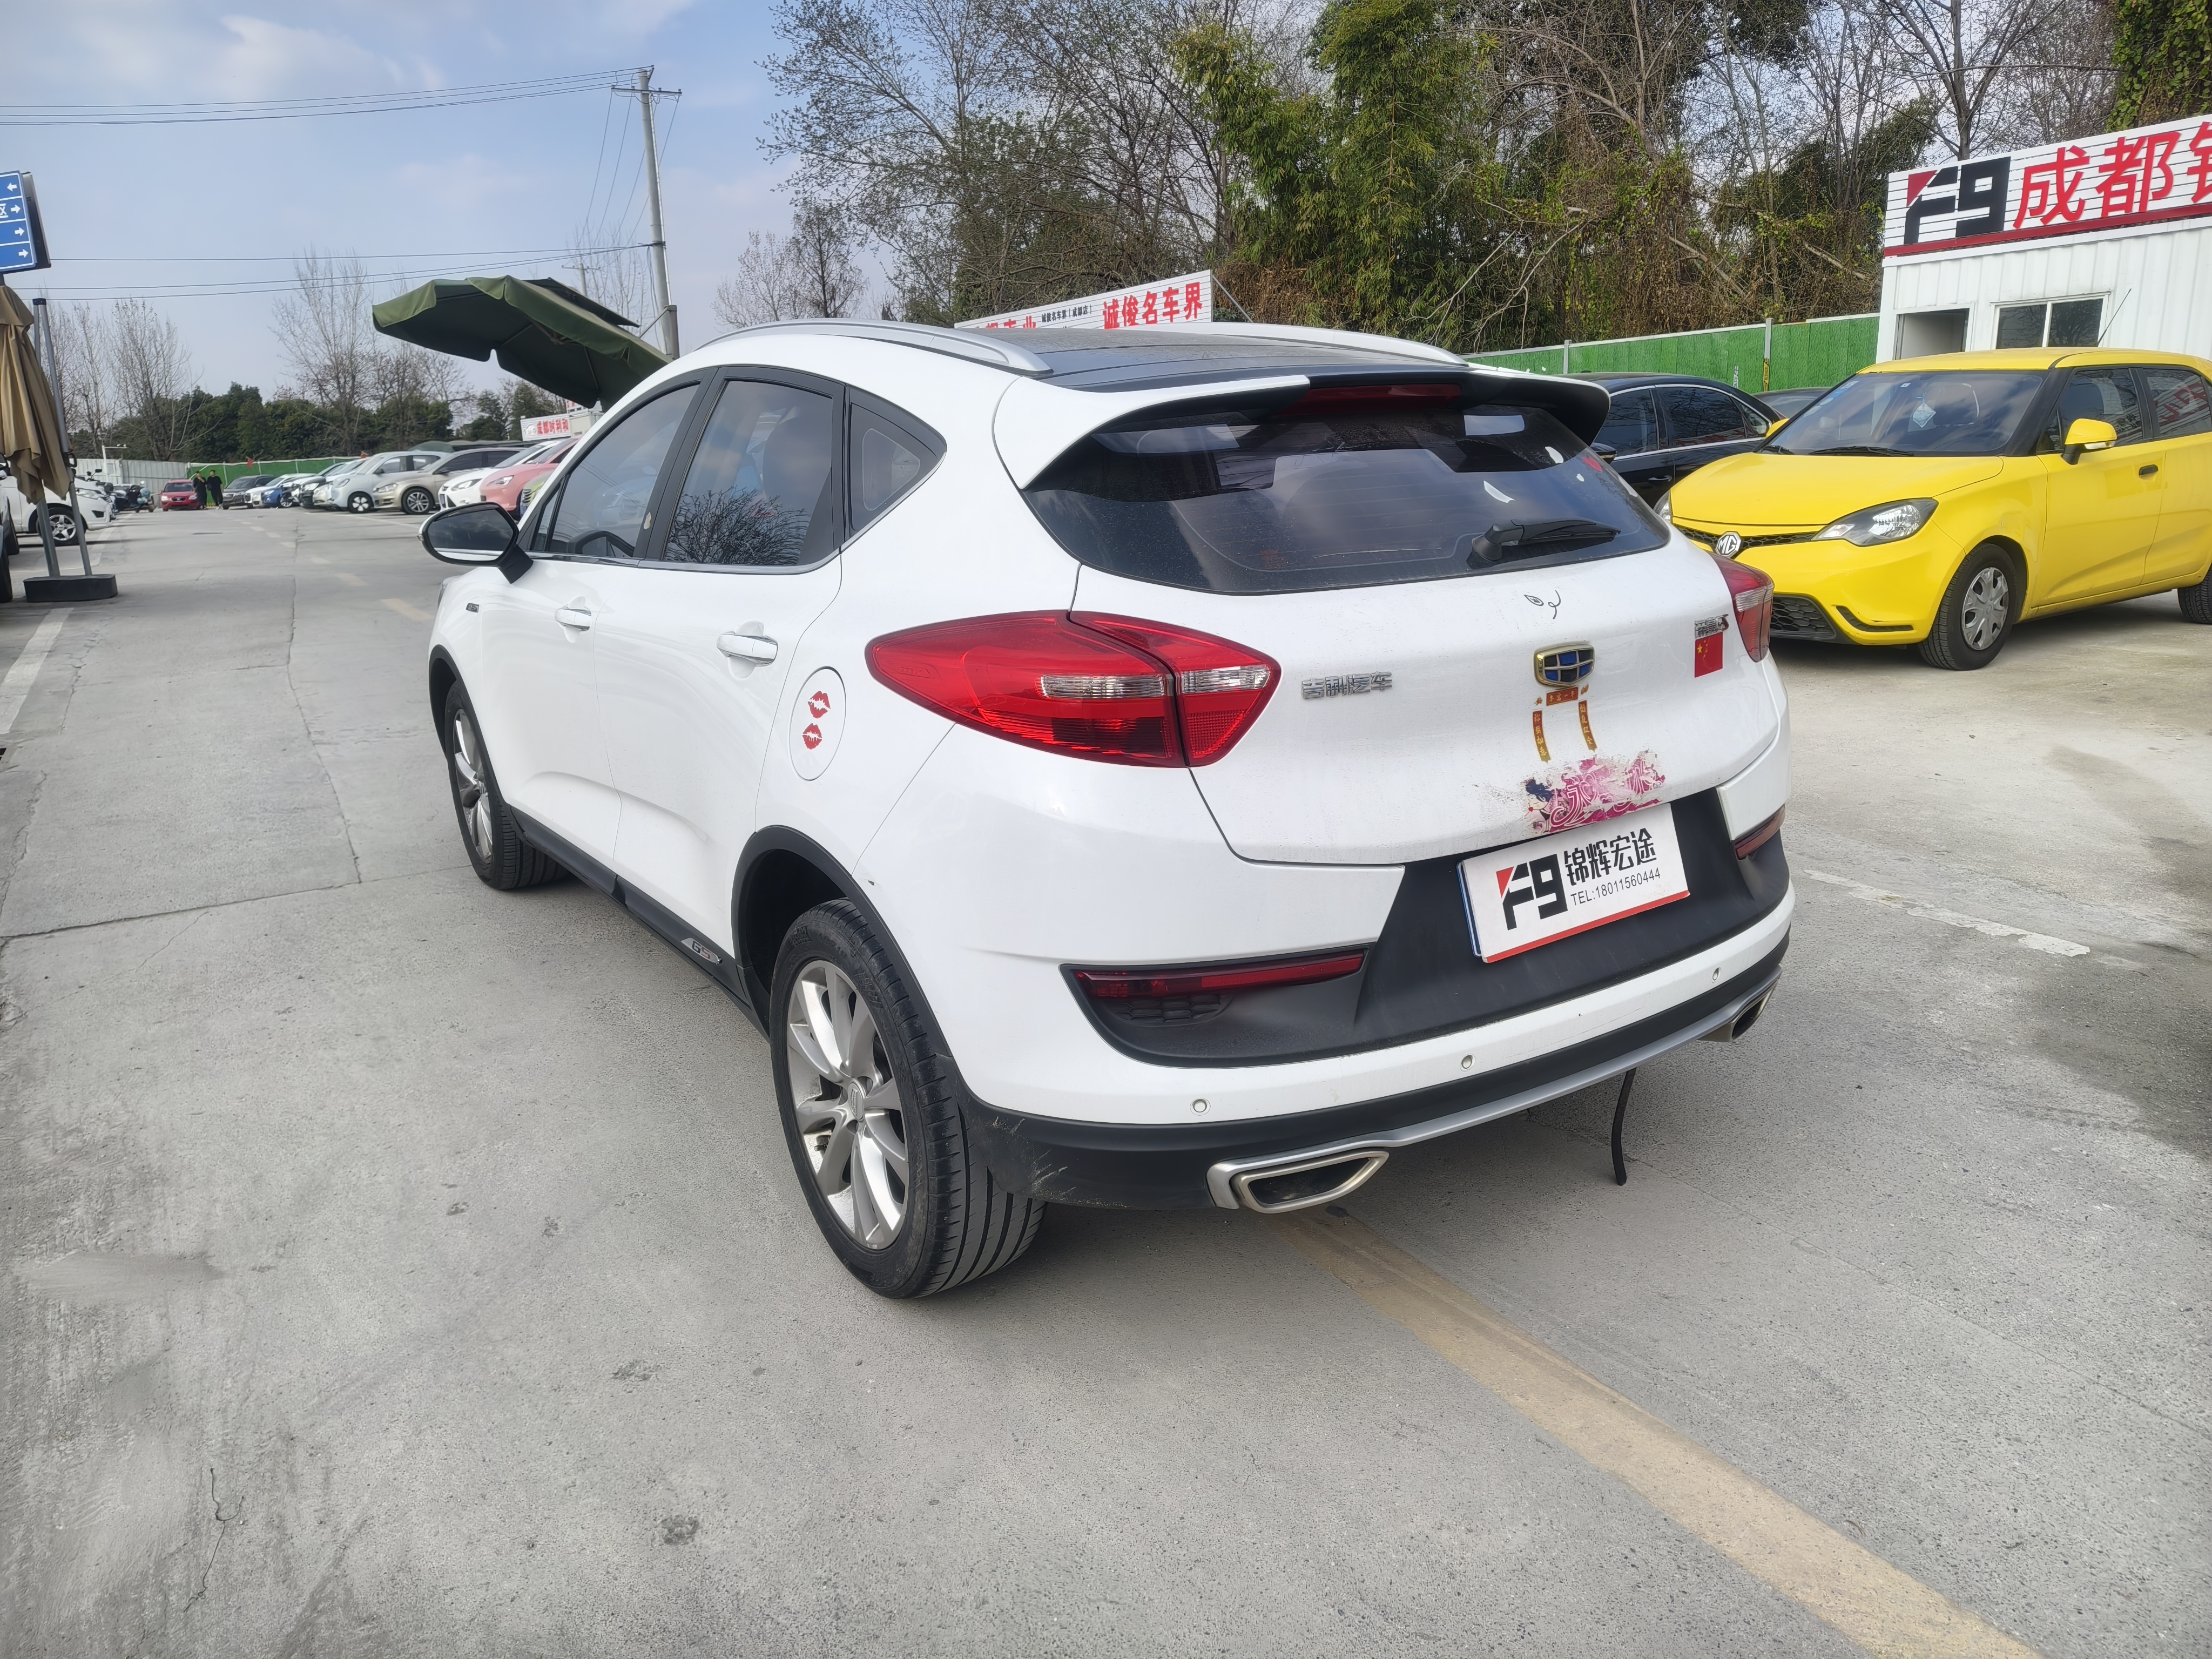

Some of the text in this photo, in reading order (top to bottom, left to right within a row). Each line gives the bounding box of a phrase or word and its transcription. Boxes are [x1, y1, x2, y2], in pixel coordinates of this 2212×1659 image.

[1103, 282, 1202, 329] 诚俊名车界
[1718, 535, 1737, 554] MG
[1301, 671, 1393, 700] 吉利汽车
[1564, 827, 1657, 886] 锦辉宏途
[1570, 867, 1661, 907] TEL:18011560444
[692, 940, 711, 959] GS
